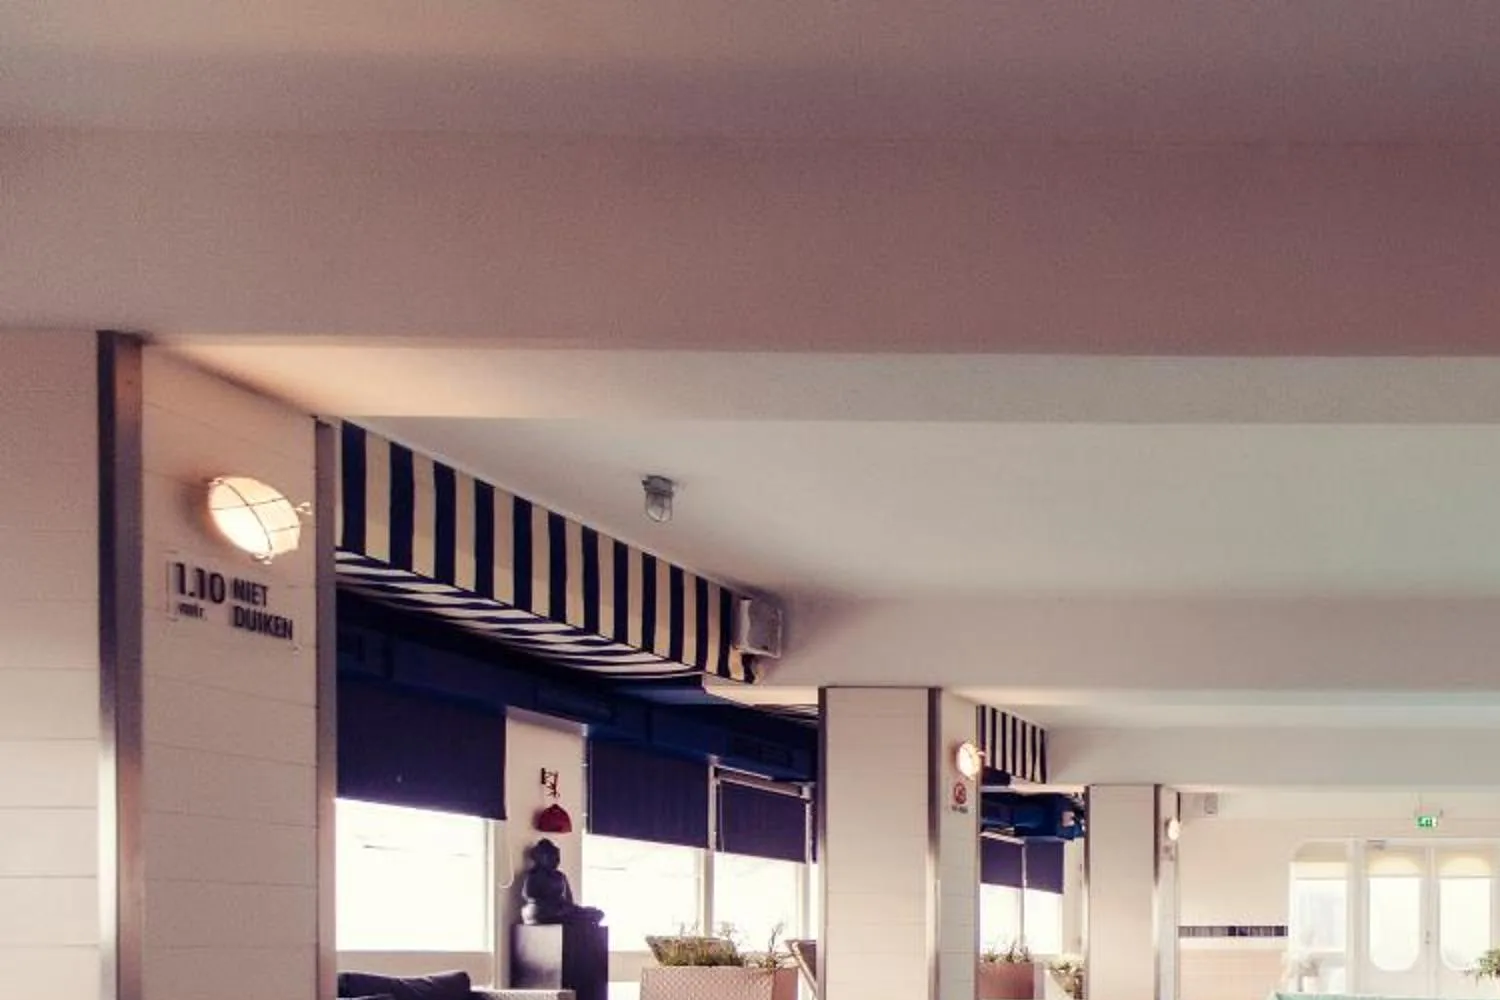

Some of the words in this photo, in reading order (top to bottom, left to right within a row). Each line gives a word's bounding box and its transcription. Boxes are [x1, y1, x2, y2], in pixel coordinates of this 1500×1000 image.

[174, 562, 226, 605] 1.10
[231, 577, 268, 608] NIET
[232, 604, 293, 641] DUIKEN
